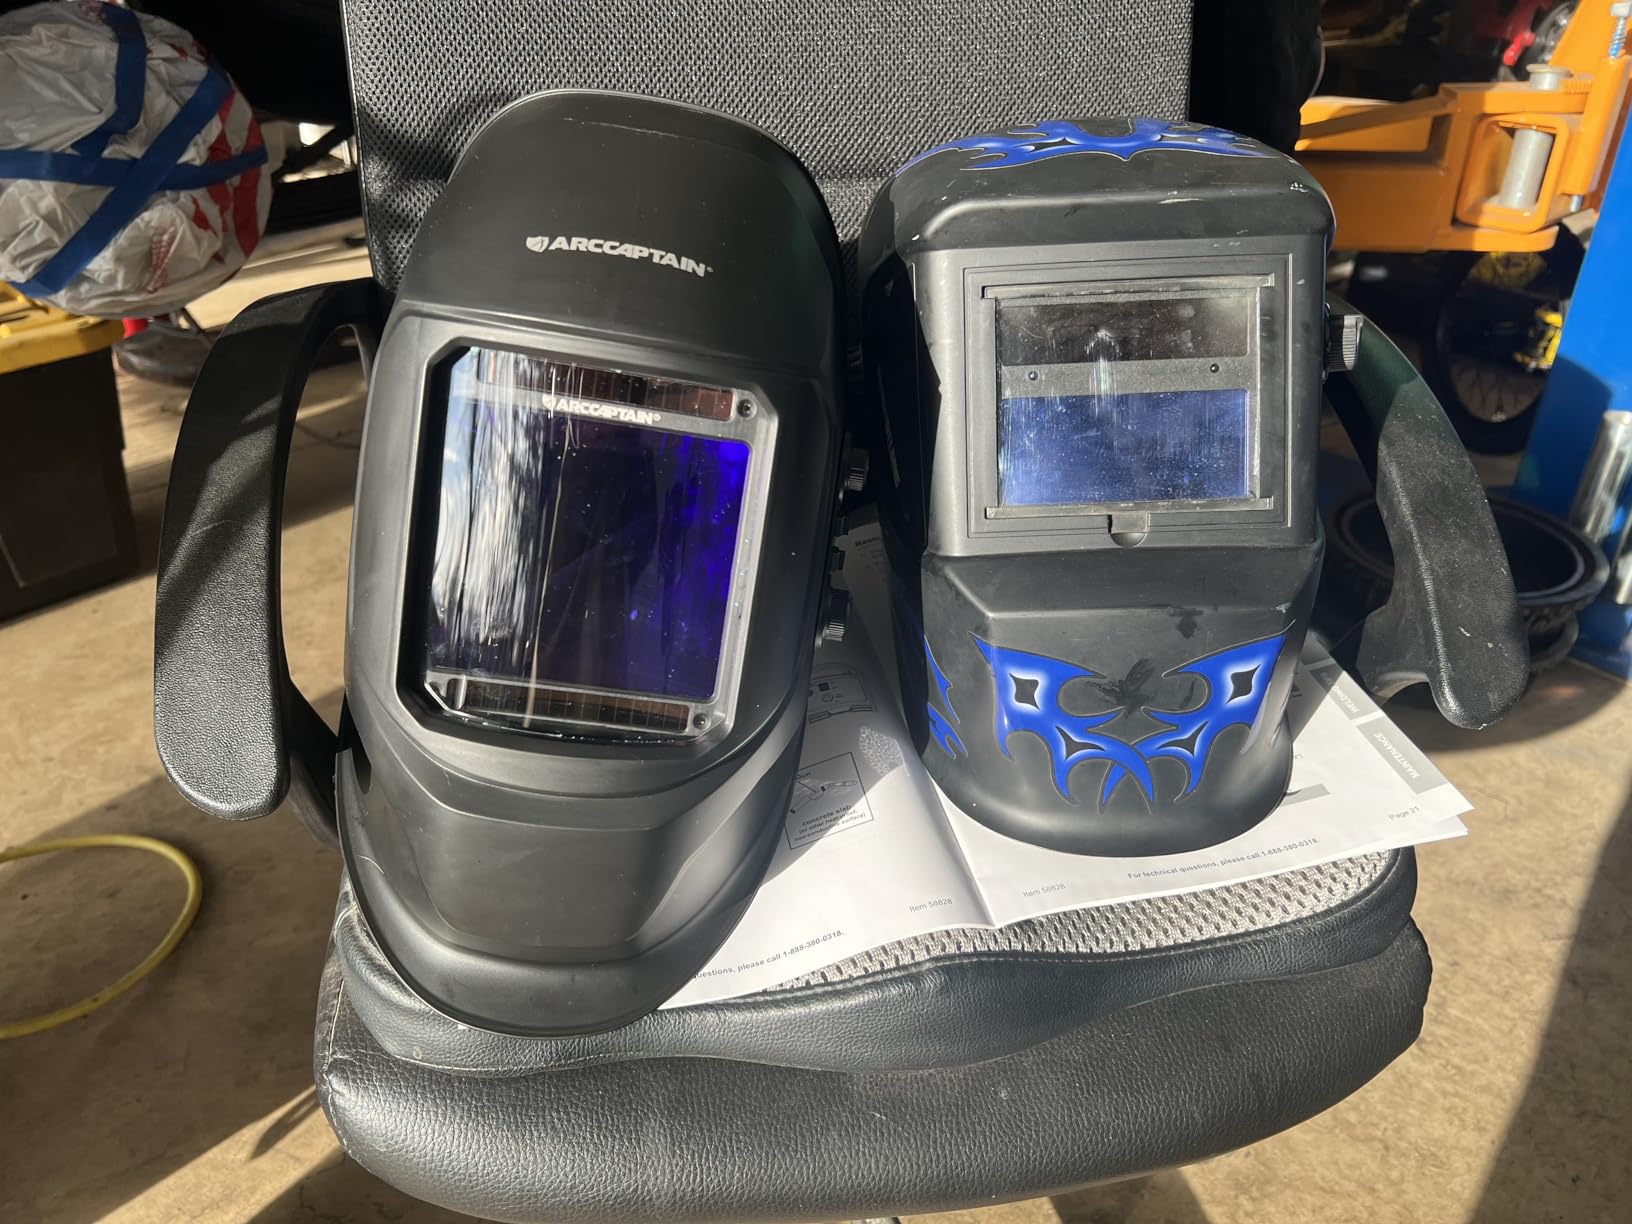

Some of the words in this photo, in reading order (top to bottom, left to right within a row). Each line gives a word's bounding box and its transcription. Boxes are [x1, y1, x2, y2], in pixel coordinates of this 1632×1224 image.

[1374, 732, 1421, 779] MAINTENANCE
[802, 811, 834, 827] concrete
[836, 804, 852, 815] slab
[1388, 810, 1409, 821] Page
[1127, 872, 1142, 880] For
[1142, 867, 1178, 878] technical
[1179, 861, 1219, 873] questions,
[1220, 855, 1246, 866] please
[1246, 852, 1260, 862] call
[1023, 888, 1041, 898] Item
[909, 903, 927, 913] Item
[928, 898, 953, 908] 58828
[737, 959, 765, 972] please
[766, 953, 781, 963] call
[783, 930, 845, 957] 1-888-380-0318.
